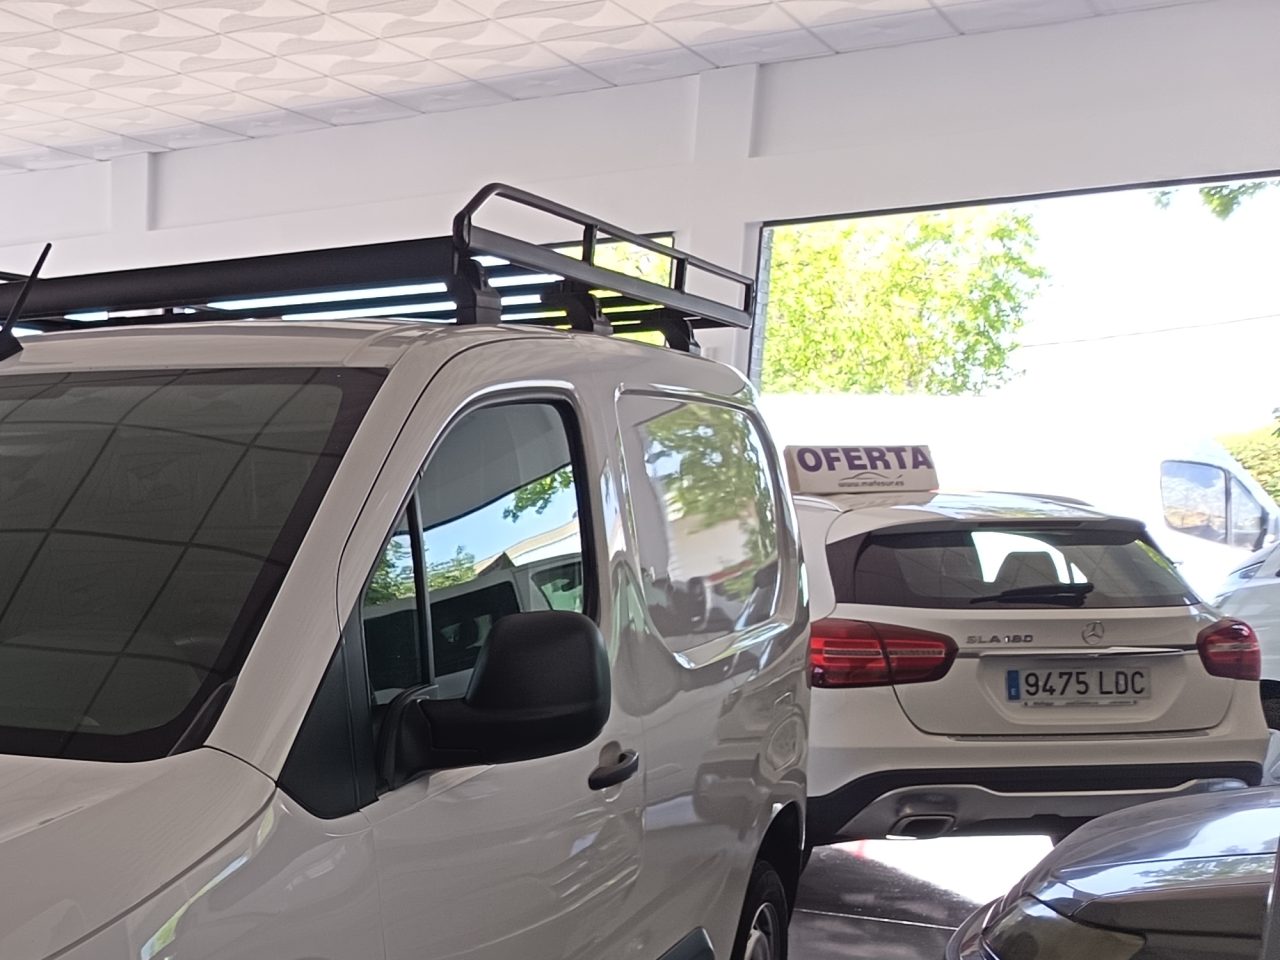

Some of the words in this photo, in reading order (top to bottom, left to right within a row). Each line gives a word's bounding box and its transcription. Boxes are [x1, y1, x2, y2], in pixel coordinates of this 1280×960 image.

[797, 446, 934, 473] OFERTA
[1024, 671, 1090, 697] 9475
[1098, 670, 1146, 696] LDC
